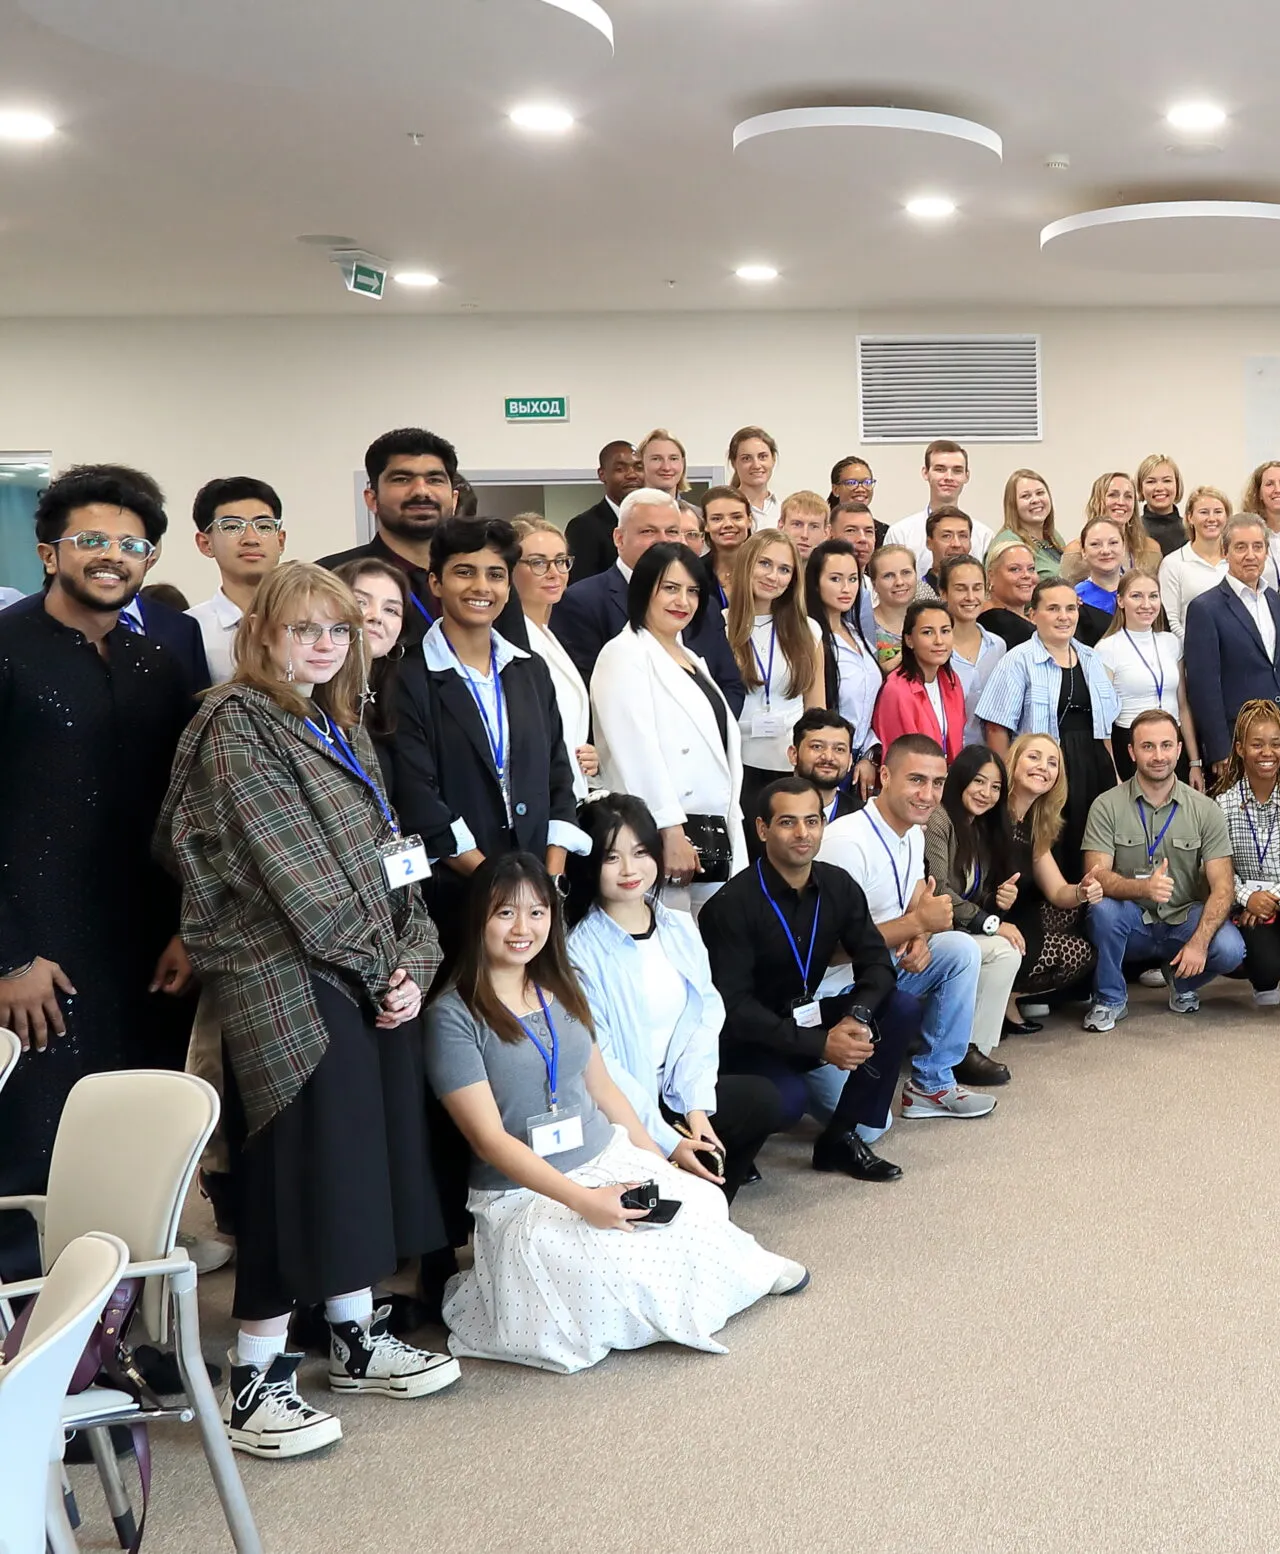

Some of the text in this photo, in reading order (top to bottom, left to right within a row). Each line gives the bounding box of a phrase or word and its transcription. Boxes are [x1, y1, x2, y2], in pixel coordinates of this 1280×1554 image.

[509, 400, 561, 415] ВЫХОД
[402, 858, 414, 875] 2
[552, 1129, 561, 1145] 1
